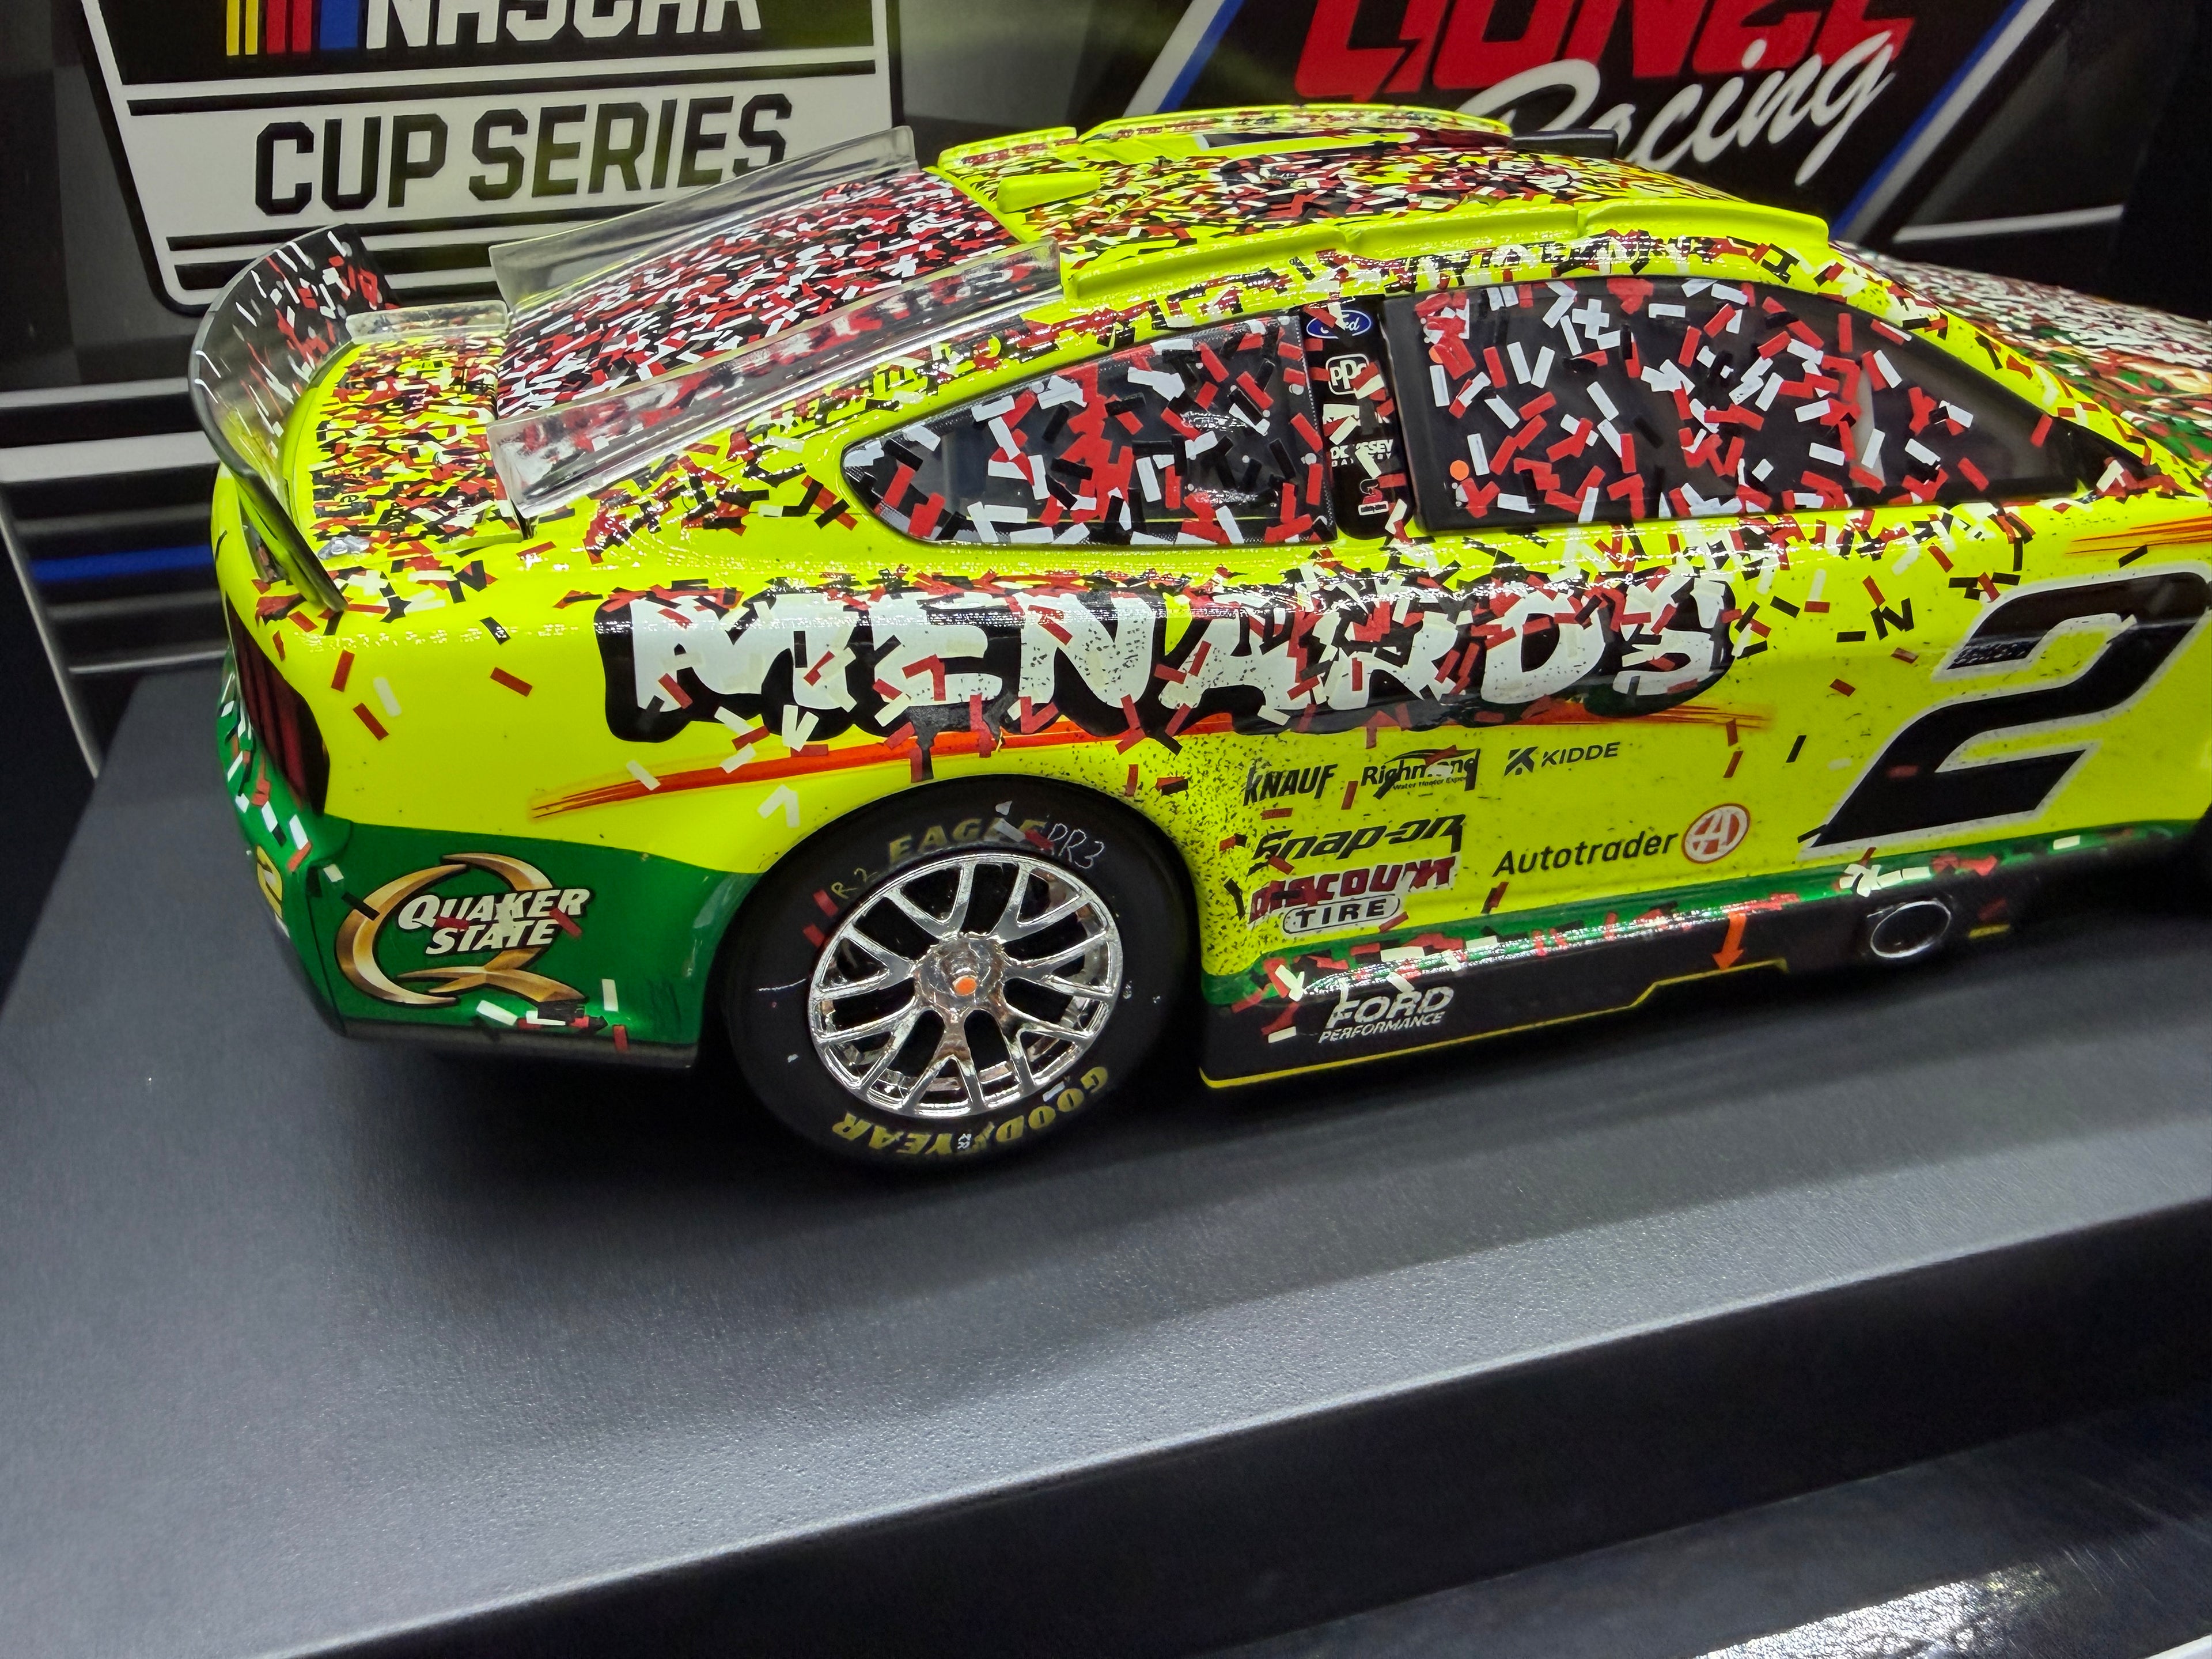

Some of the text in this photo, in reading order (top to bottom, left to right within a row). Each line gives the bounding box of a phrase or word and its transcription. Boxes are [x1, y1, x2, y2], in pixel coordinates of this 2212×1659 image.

[255, 93, 793, 217] CUP SERIES
[1330, 438, 1394, 460] ODSEY
[1798, 561, 2212, 859] 2
[1540, 741, 1620, 768] KIDDE
[1243, 762, 1338, 806] KNAUF
[1246, 813, 1467, 878] Snap-on
[1491, 830, 1679, 877] Autotrader
[397, 888, 591, 930] QUAKER
[1295, 899, 1387, 929] TIRE
[425, 919, 560, 955] STATE
[1317, 1010, 1446, 1044] PERFORMANCE
[1325, 986, 1455, 1029] FORD
